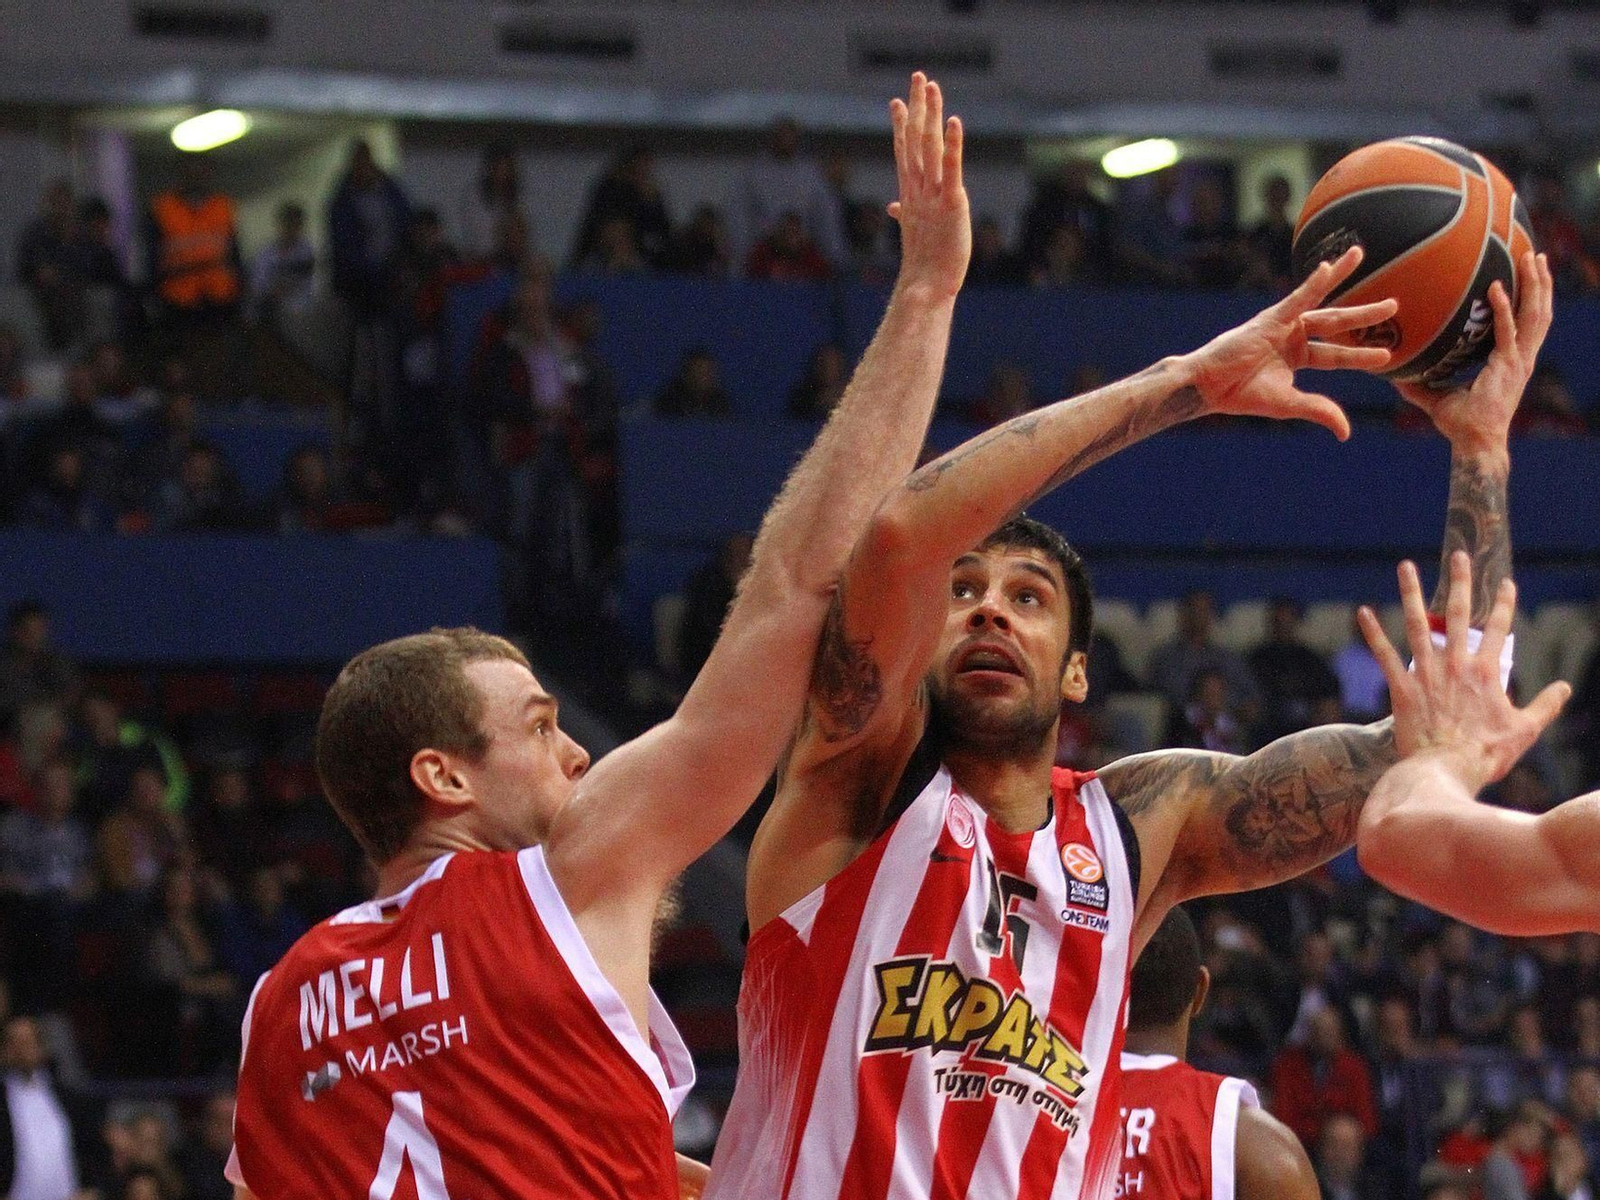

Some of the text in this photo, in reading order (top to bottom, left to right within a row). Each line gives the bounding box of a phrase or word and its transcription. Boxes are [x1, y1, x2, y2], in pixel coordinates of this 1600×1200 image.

[976, 856, 1038, 976] 15
[1061, 909, 1109, 932] ONE TEAM
[299, 932, 451, 1051] MELLI
[345, 1014, 469, 1078] MARSH
[1119, 1107, 1156, 1158] R
